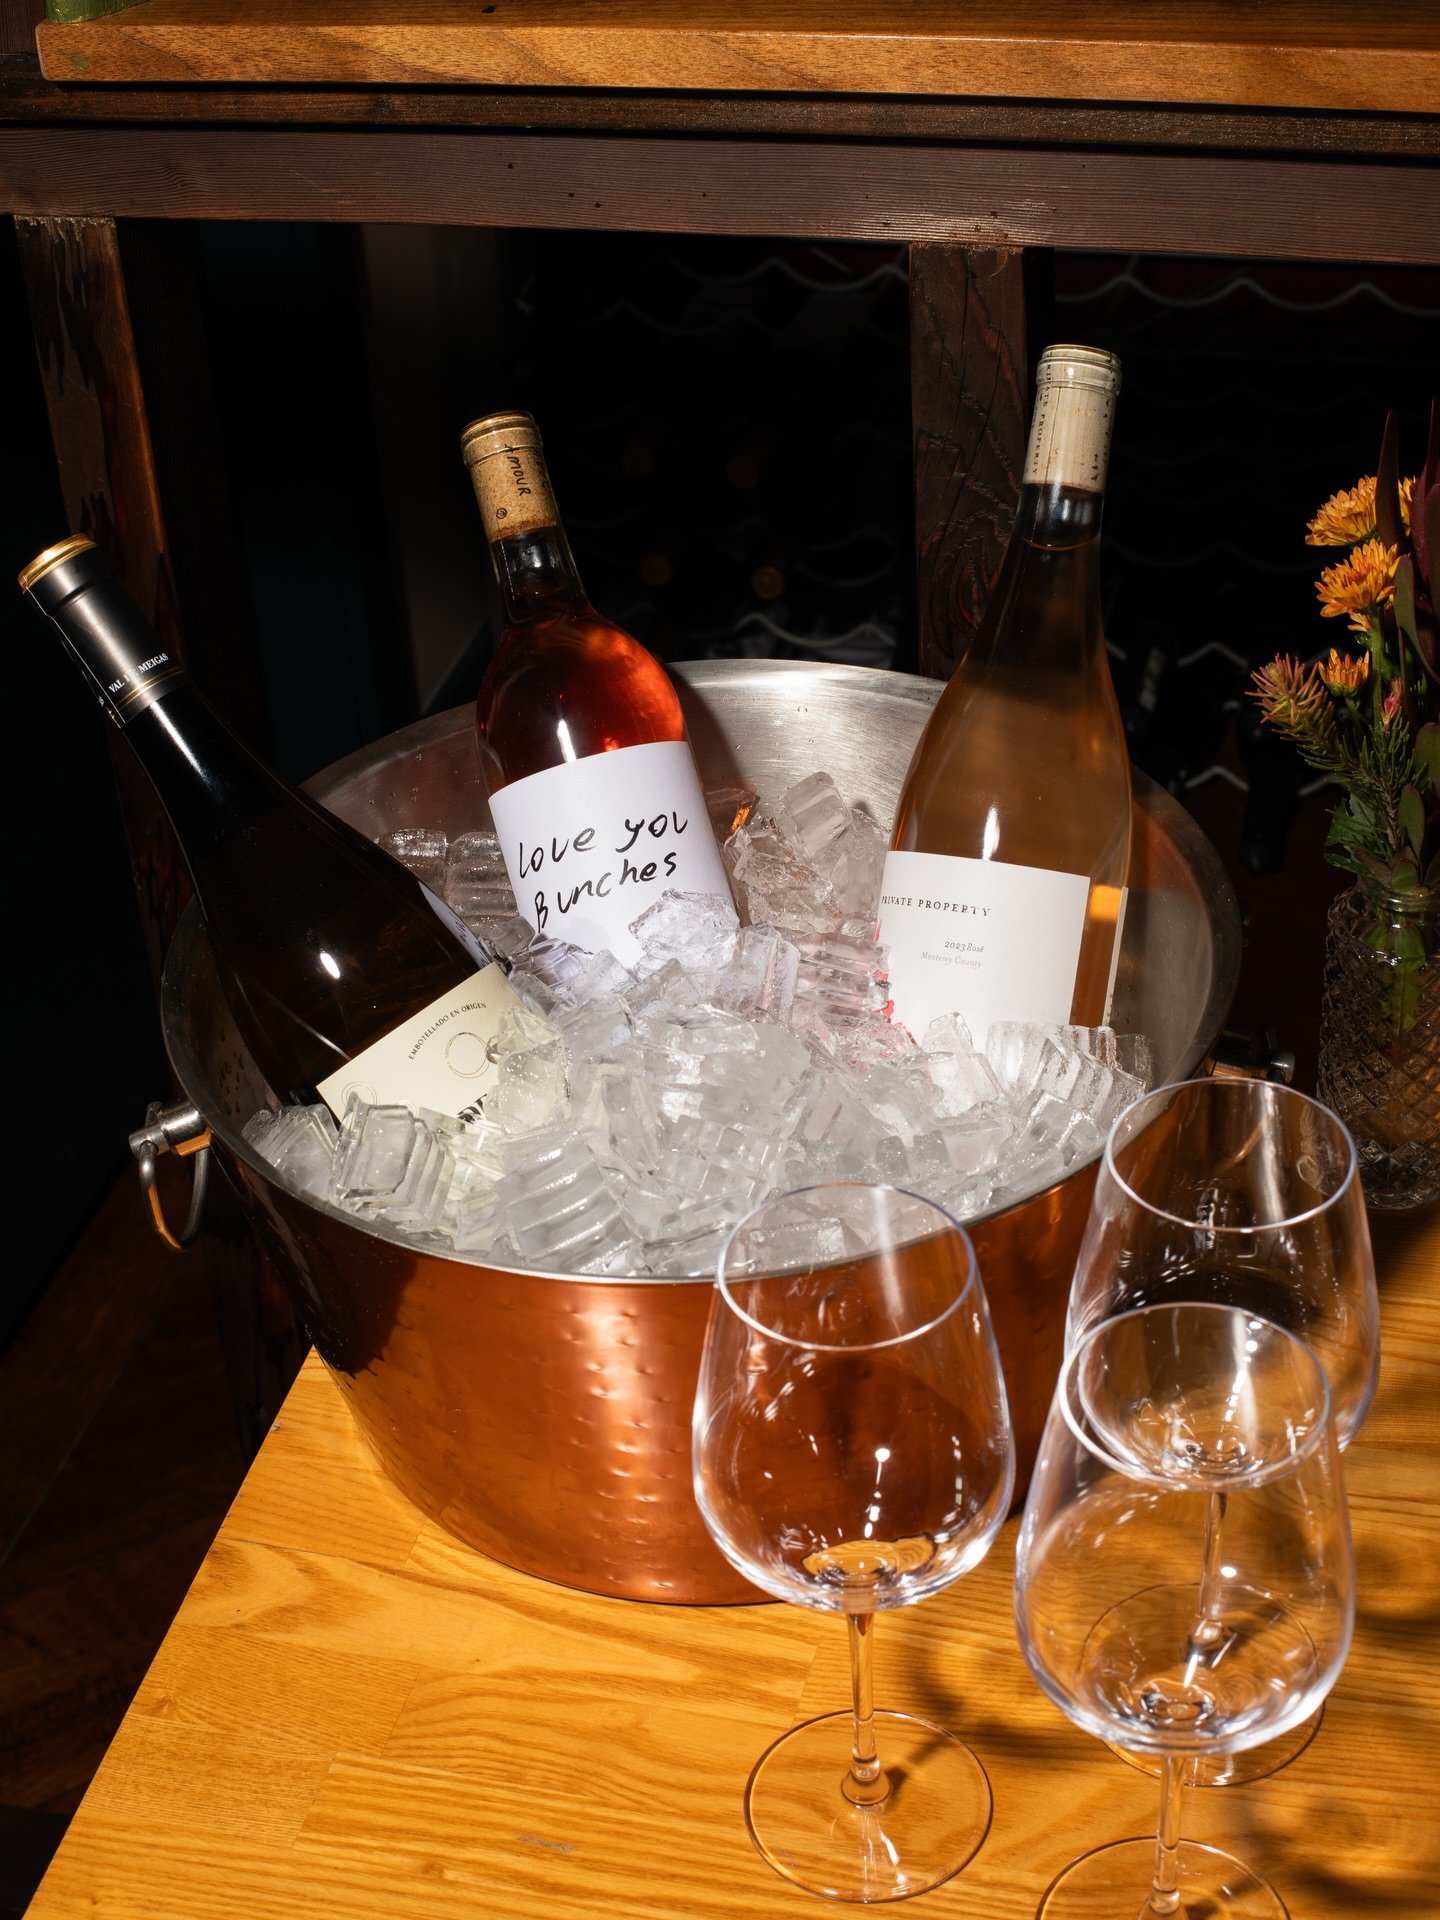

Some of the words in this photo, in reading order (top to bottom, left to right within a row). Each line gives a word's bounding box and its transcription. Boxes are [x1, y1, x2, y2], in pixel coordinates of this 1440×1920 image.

[108, 679, 125, 694] VAL
[137, 652, 169, 673] MEIGAS
[881, 895, 913, 907] PRIVATE
[918, 899, 991, 917] PROPERTY
[944, 941, 966, 952] 2023
[407, 1014, 450, 1061] EMBOTELLADO
[450, 1008, 461, 1019] EN
[461, 1001, 487, 1013] ORIGEN
